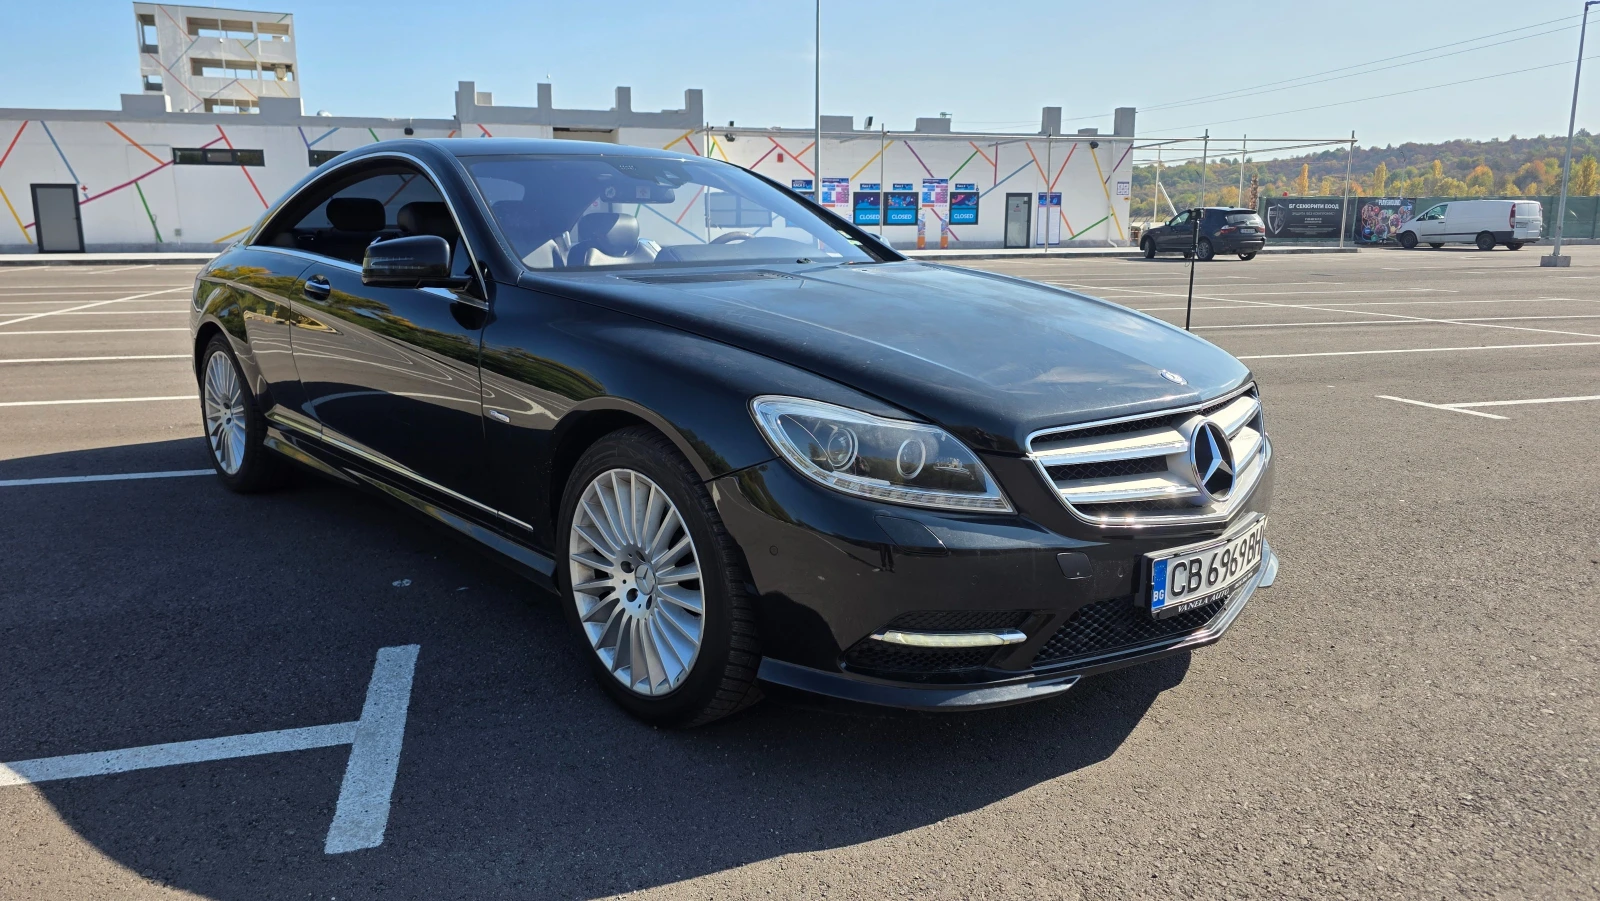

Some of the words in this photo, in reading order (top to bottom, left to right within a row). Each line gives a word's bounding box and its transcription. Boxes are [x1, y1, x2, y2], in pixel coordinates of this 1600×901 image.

[1171, 557, 1203, 597] CB
[1153, 589, 1165, 602] BG
[1177, 597, 1209, 613] VANELA
[1210, 588, 1230, 603] AUTO
